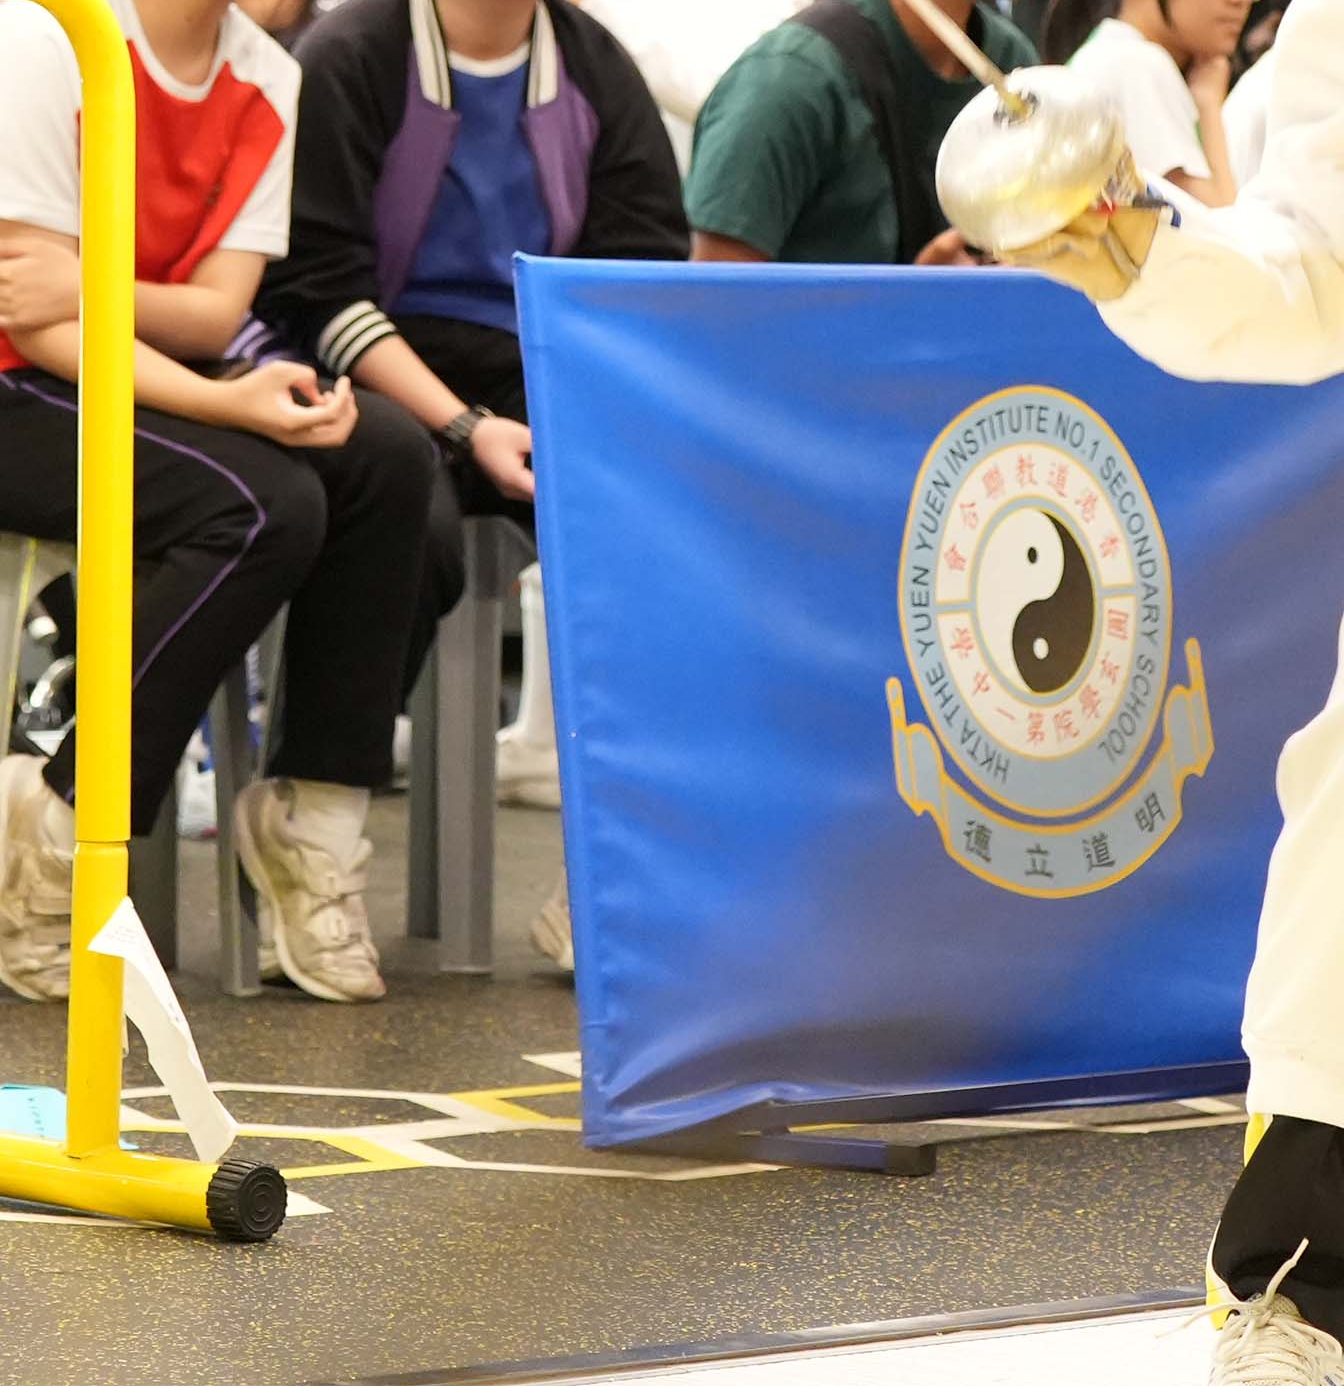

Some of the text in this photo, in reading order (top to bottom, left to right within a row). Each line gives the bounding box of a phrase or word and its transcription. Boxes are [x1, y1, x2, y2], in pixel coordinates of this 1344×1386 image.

[911, 405, 1160, 784] HKTA THE YUEN YUEN INSTITUTE NO.1 SECONDARY SCHOOL
